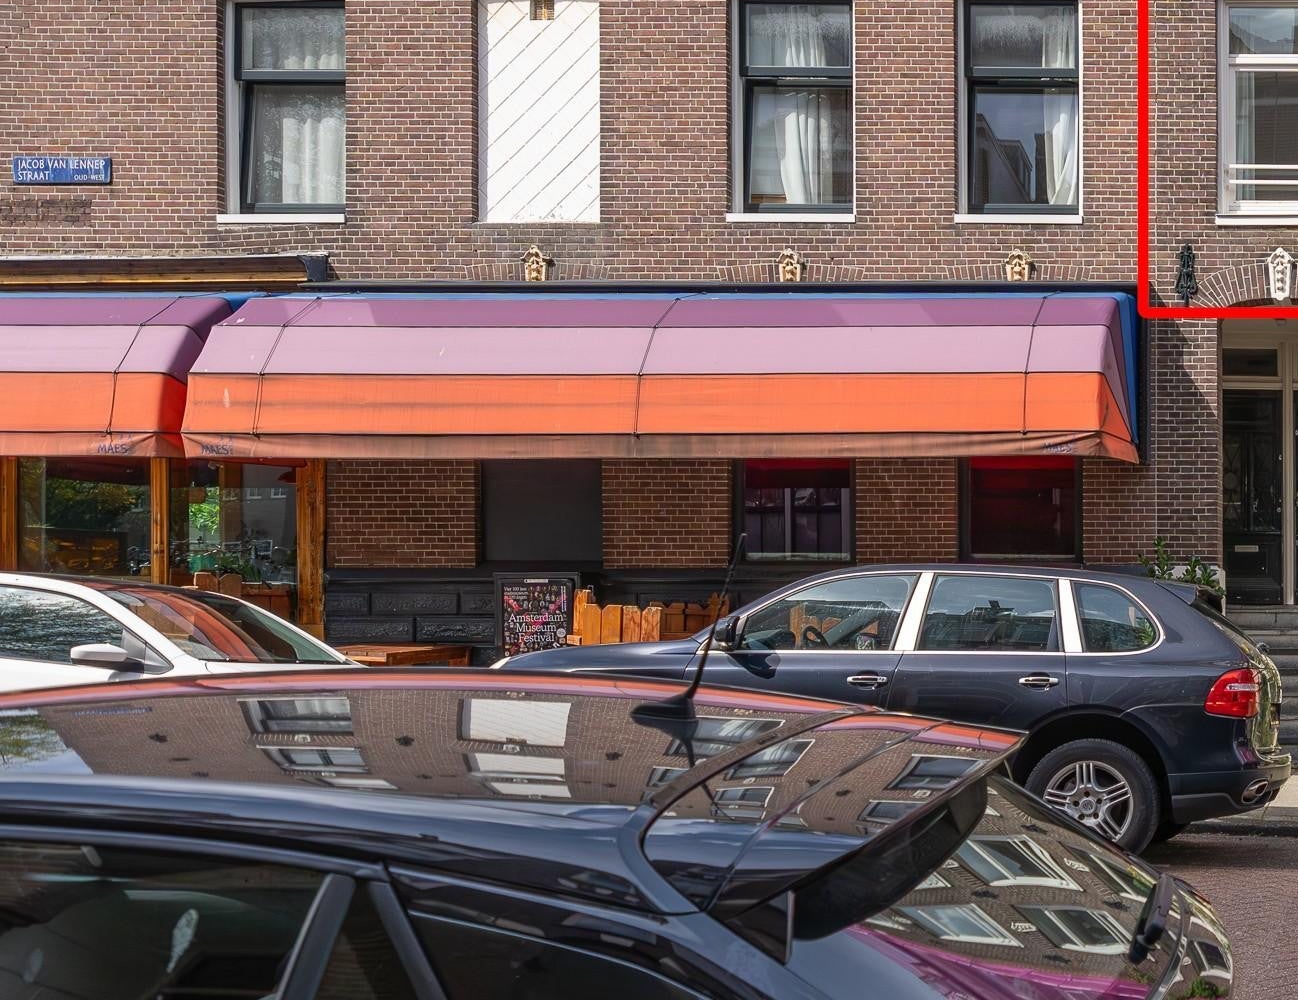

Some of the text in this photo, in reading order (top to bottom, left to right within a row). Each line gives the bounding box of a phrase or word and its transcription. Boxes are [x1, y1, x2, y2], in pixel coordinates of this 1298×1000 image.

[18, 160, 105, 170] JACOB VAN LENNEP
[18, 171, 50, 180] STRAAT
[509, 613, 564, 622] Amsterdam
[516, 623, 557, 632] Museum
[519, 633, 554, 642] Festival
